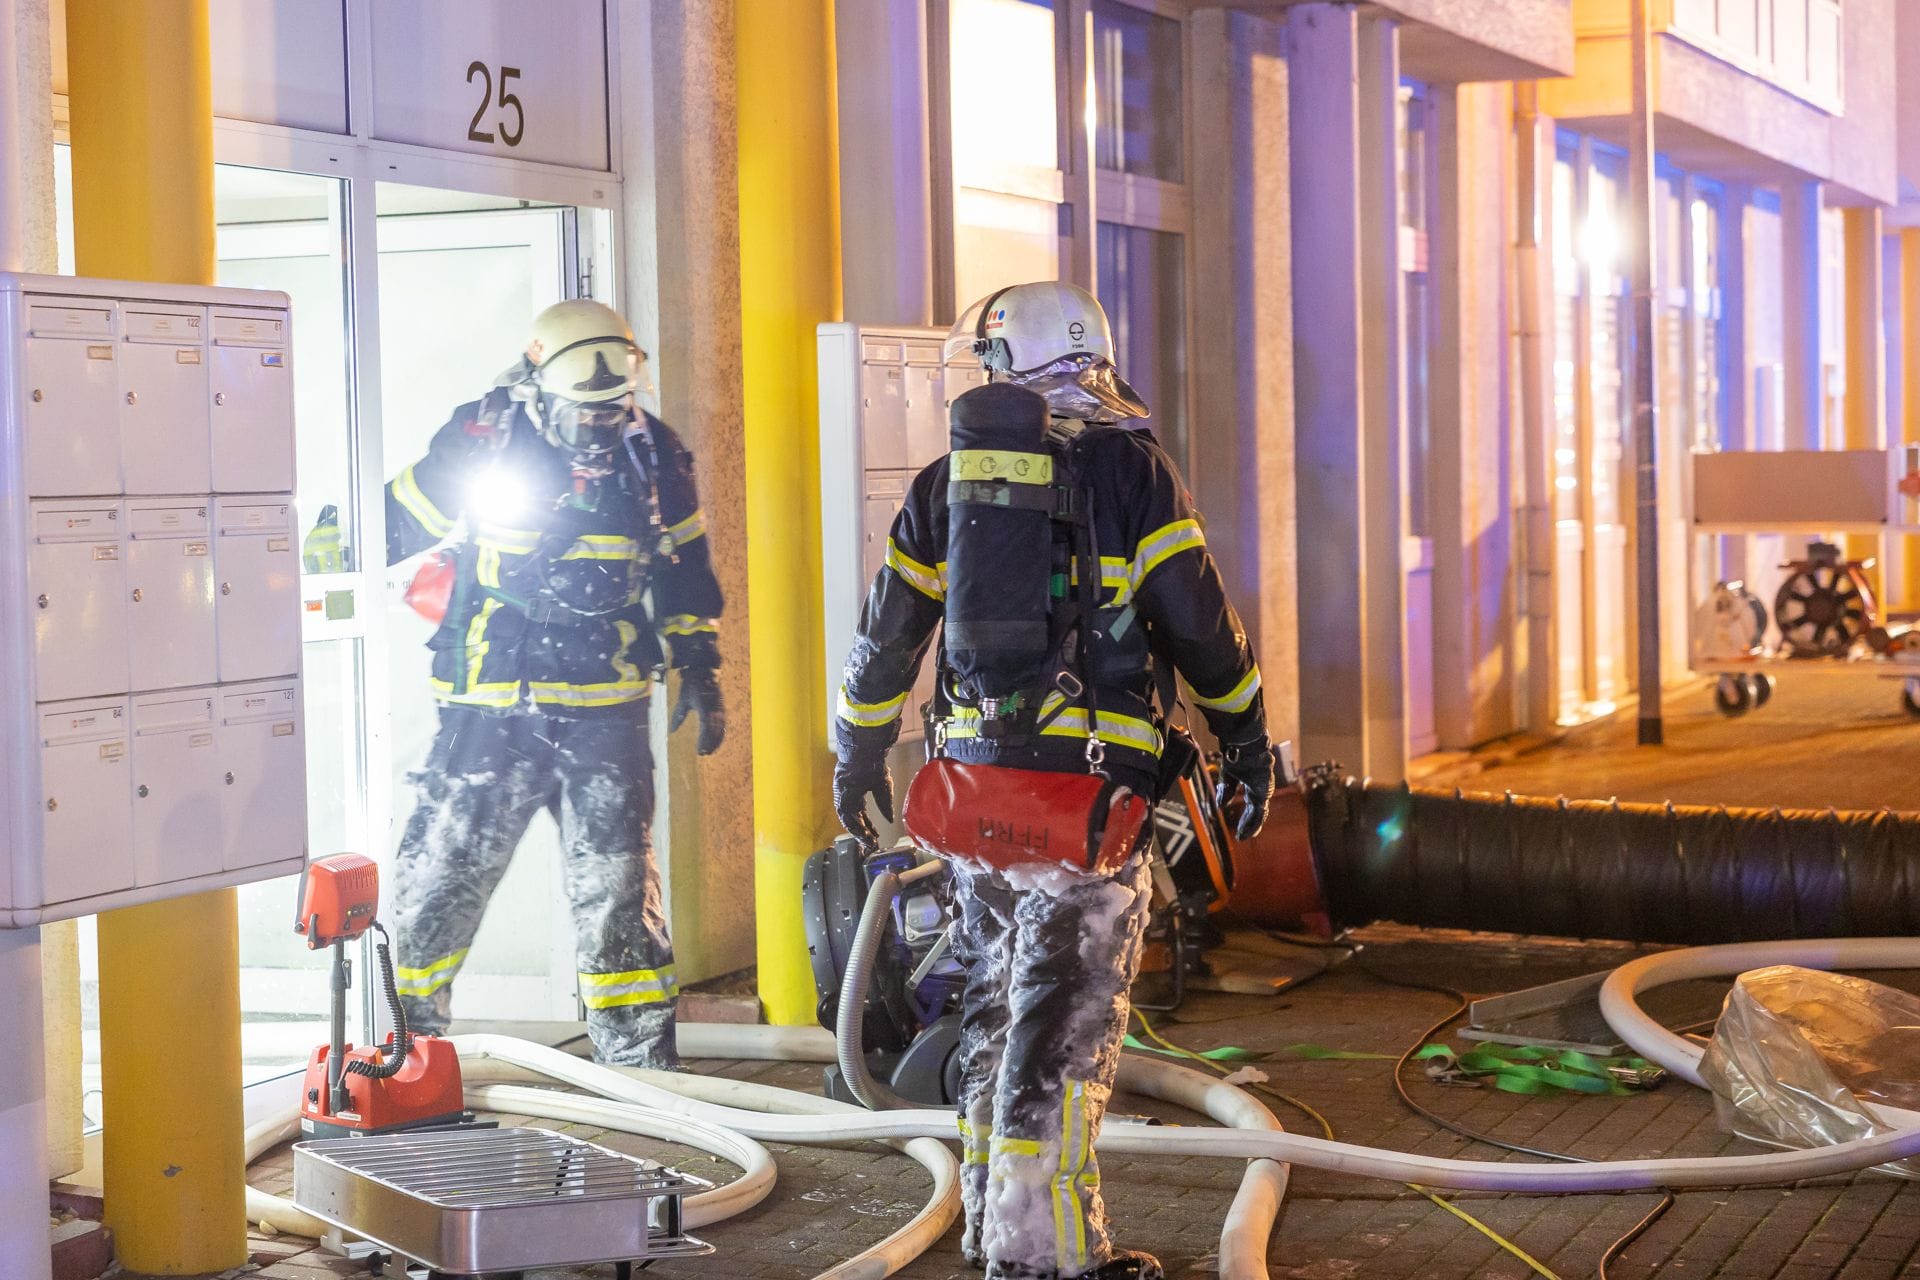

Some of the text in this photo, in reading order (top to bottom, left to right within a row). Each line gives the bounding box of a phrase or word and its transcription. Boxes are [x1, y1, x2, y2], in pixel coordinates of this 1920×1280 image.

[466, 61, 524, 147] 25
[187, 318, 200, 327] 122
[108, 511, 117, 520] 45
[284, 690, 295, 700] 121
[206, 700, 212, 709] 9
